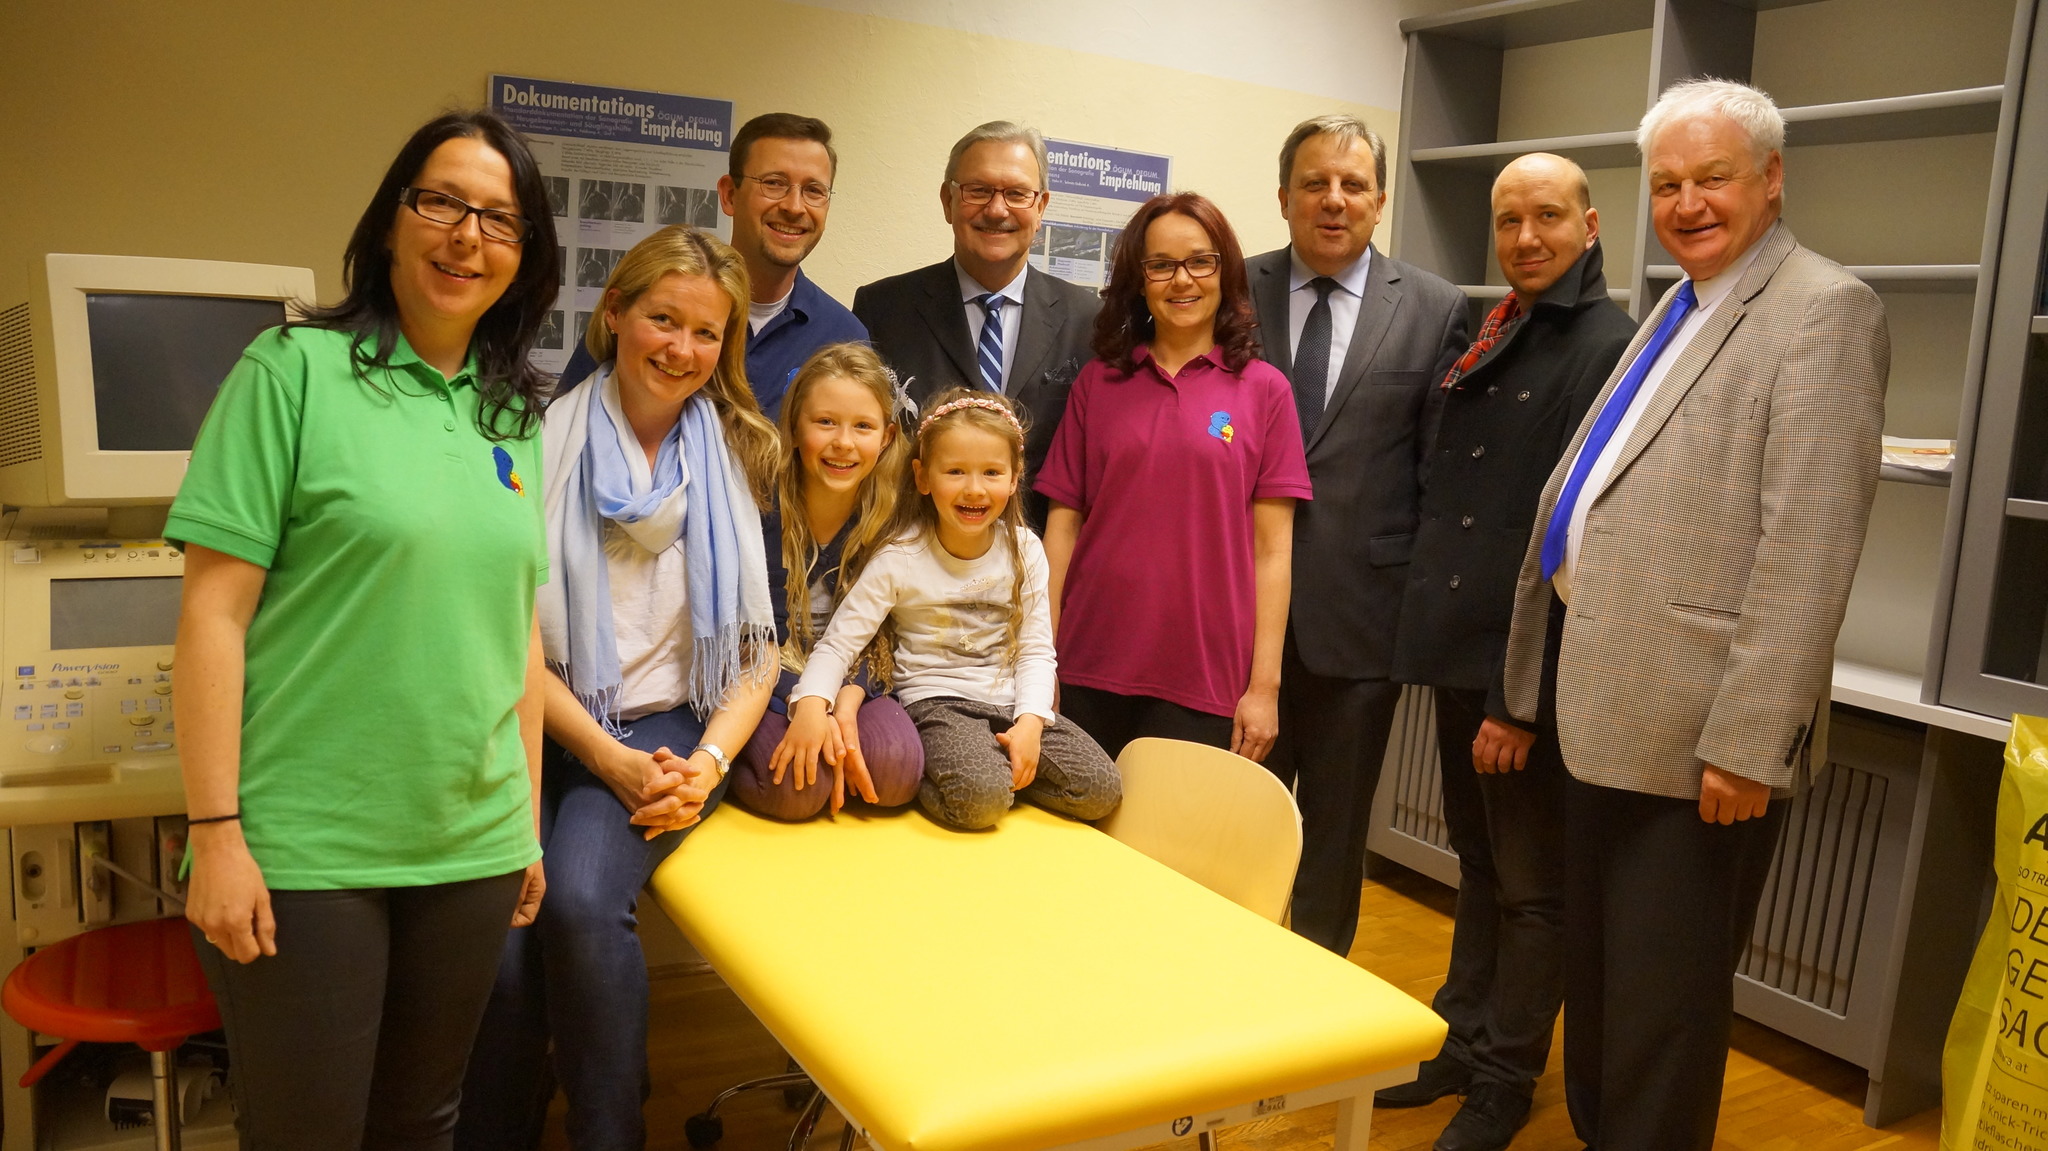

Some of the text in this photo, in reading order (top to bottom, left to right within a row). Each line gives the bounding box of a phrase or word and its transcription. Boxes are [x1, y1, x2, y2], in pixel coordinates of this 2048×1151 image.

[503, 84, 655, 119] Dokumentations
[640, 118, 723, 147] Empfehlung
[688, 115, 718, 127] DEGUM
[1099, 171, 1161, 195] Empfehlung
[1993, 1088, 2029, 1114] sparen
